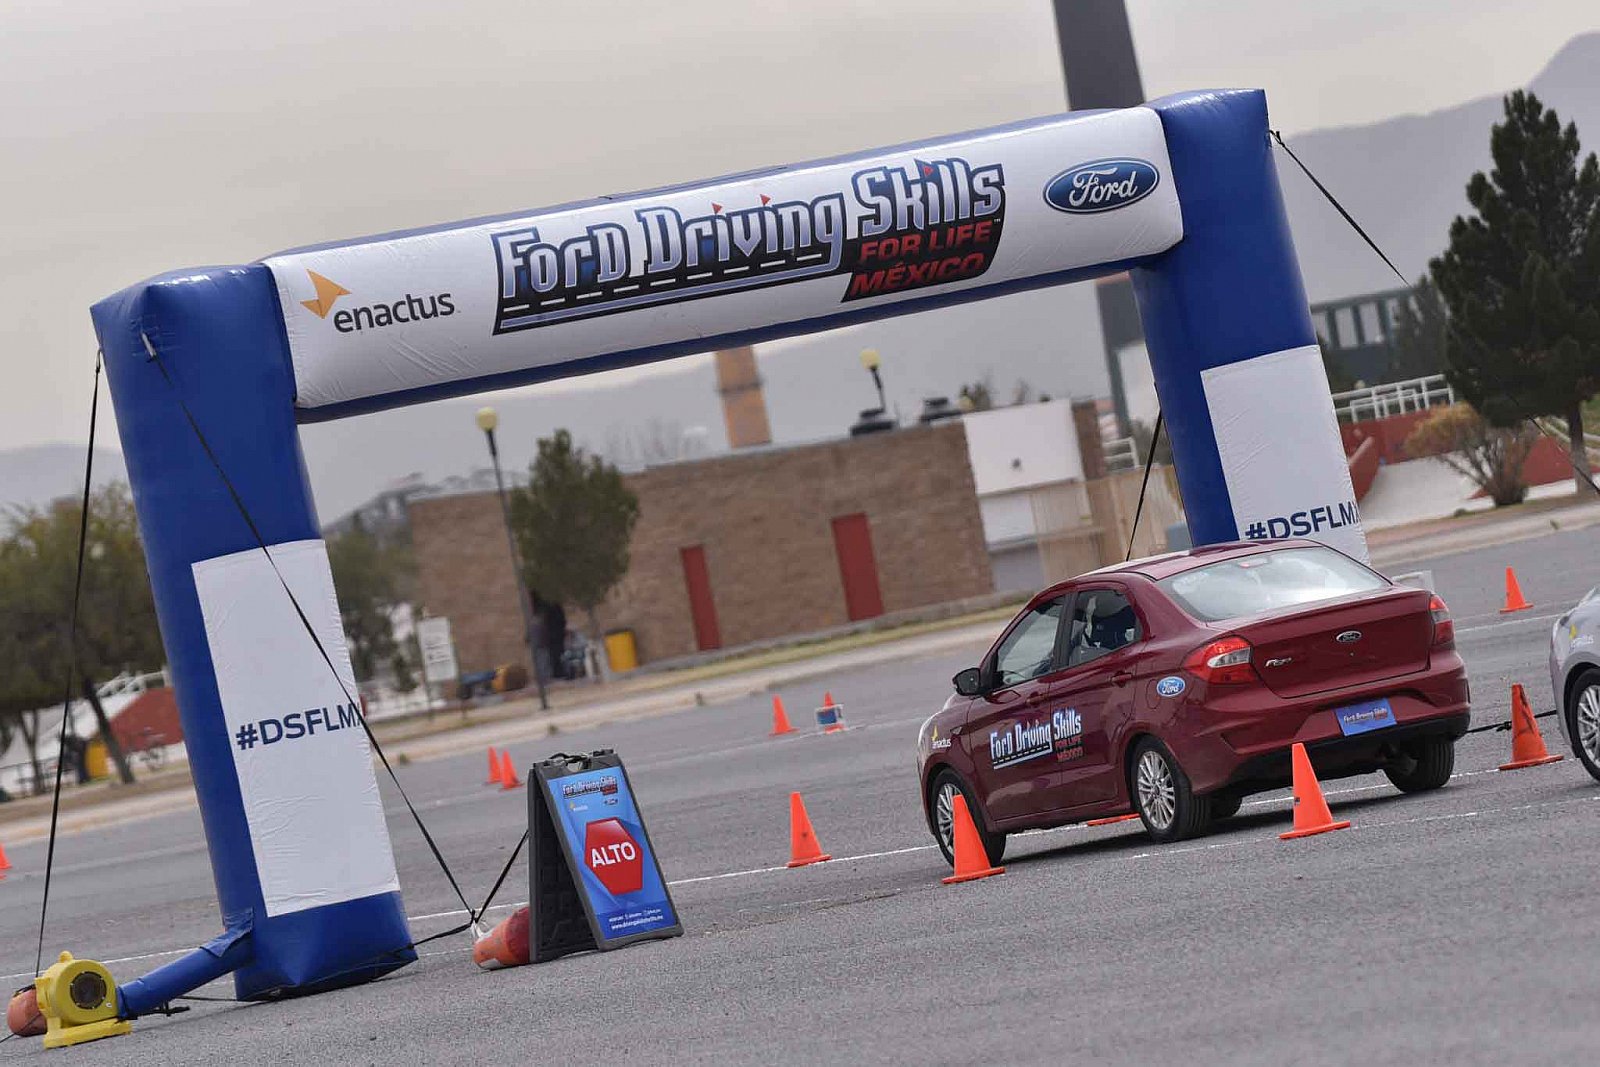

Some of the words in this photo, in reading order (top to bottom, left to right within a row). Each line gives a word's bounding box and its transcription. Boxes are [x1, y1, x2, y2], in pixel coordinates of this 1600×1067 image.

[1068, 166, 1139, 207] Ford
[634, 192, 846, 273] Driving
[851, 157, 1005, 238] Skills
[859, 234, 922, 264] FOR
[928, 222, 993, 252] LIFE
[849, 252, 986, 298] MÉXICO
[333, 292, 455, 333] enactus
[1053, 708, 1082, 741] Skills
[591, 841, 636, 868] ALTO
